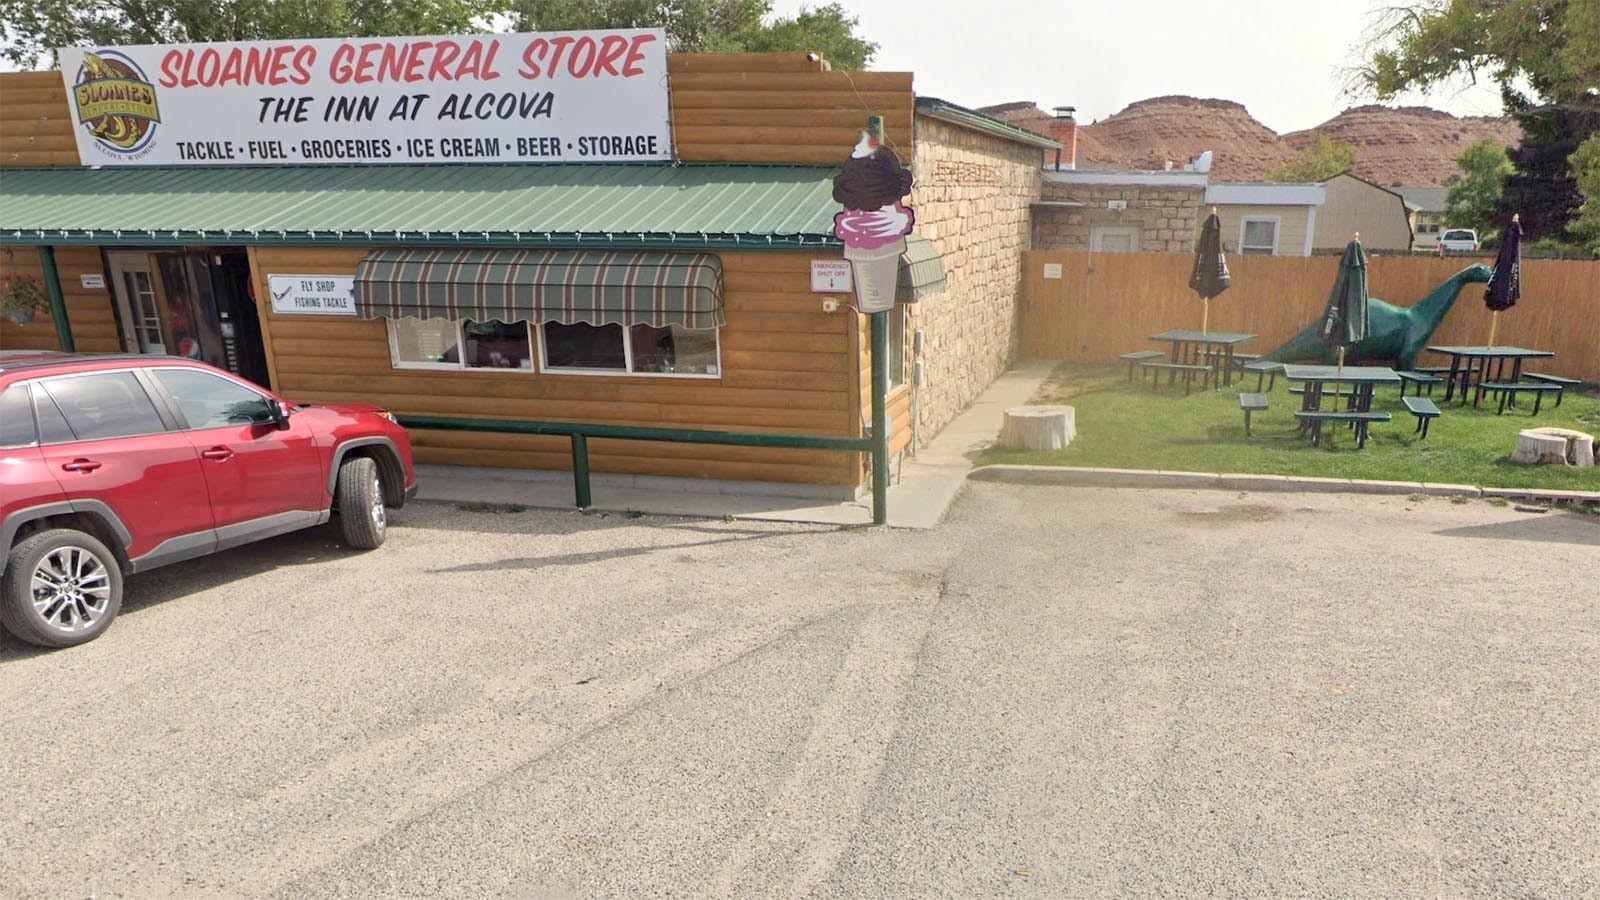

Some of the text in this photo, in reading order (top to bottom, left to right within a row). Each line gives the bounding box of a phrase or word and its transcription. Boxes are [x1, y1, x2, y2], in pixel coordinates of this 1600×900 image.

[159, 34, 657, 88] SLOANES GENERAL STORE
[80, 84, 152, 106] SLOANES
[258, 91, 555, 123] THE INN AT ALCOVA
[176, 135, 658, 160] TACKLE FUEL GROCERIES ICE CREAM BEER STORAGE
[301, 280, 336, 292] FLY SHOP
[294, 297, 348, 309] FISHING TACKLE
